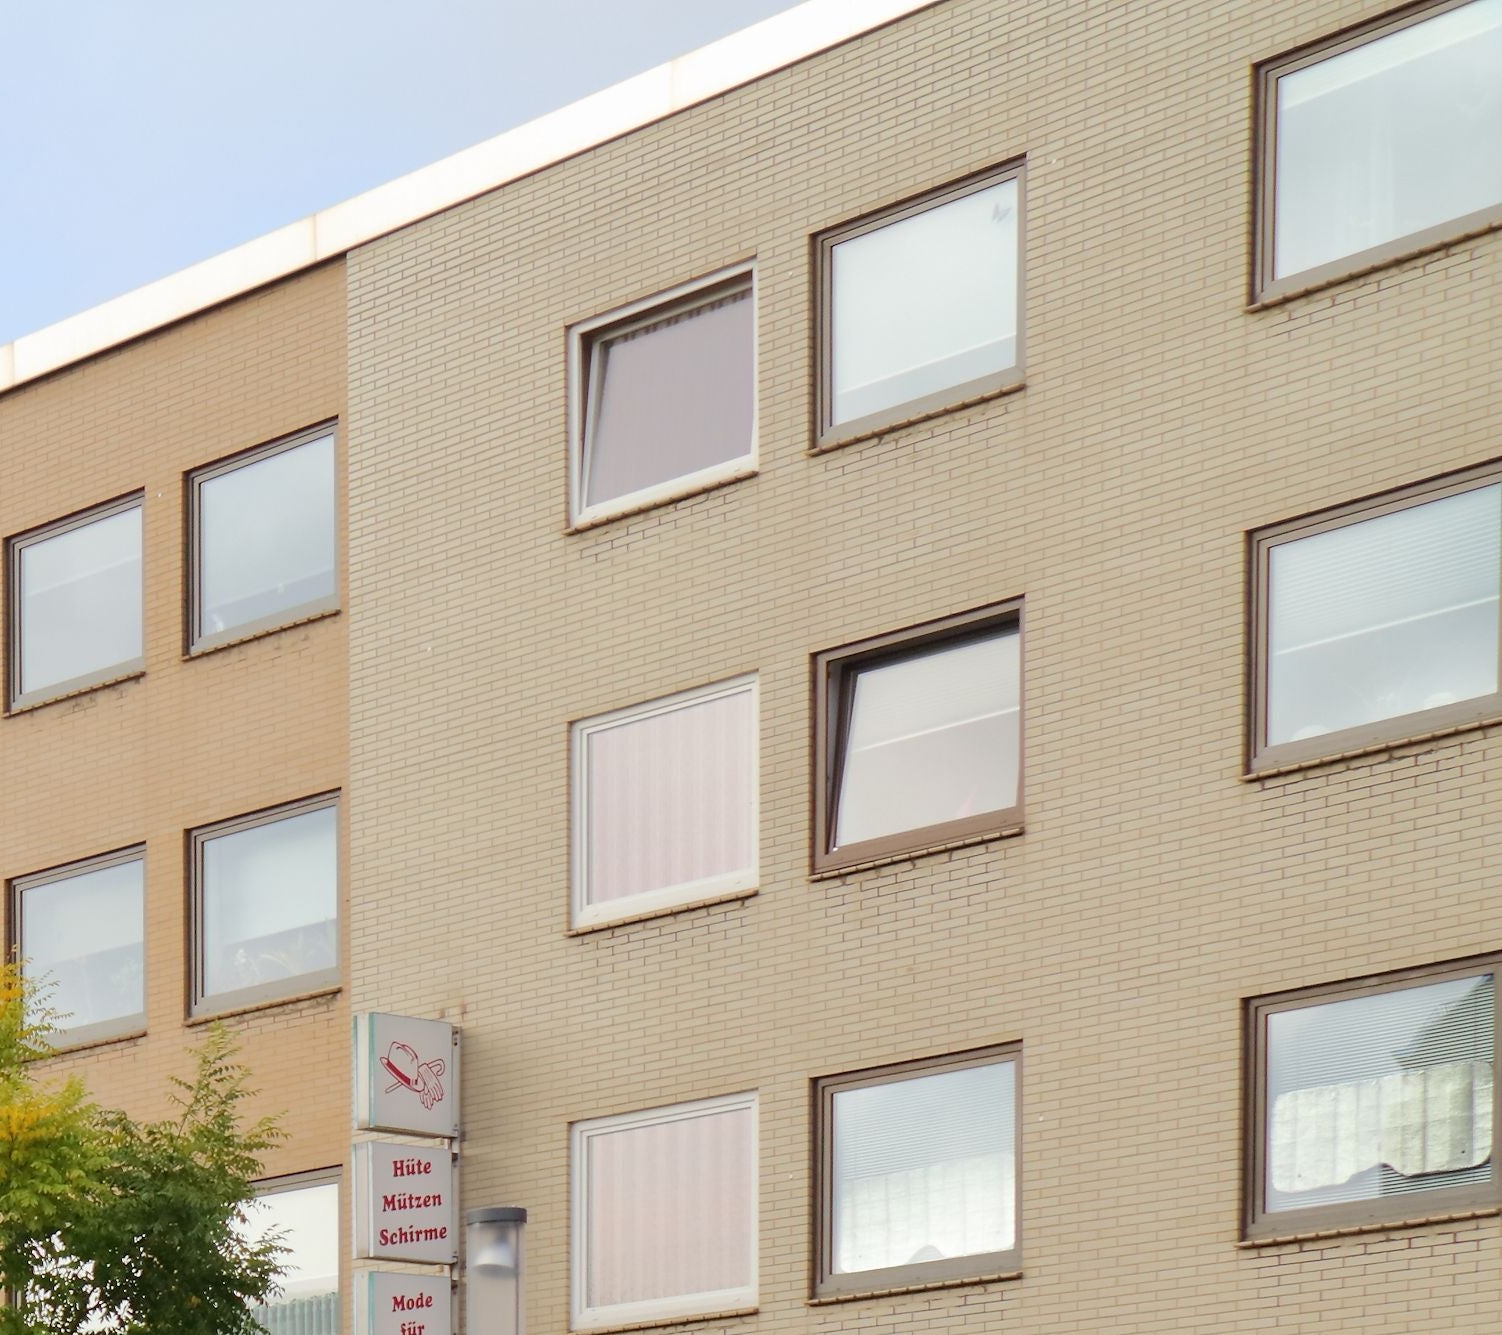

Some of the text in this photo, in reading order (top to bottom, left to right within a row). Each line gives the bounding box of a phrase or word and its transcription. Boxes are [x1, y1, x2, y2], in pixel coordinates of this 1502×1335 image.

[392, 1158, 432, 1177] Hüte
[382, 1192, 442, 1212] Mützen
[379, 1225, 447, 1246] Schirme
[392, 1292, 433, 1312] Mode
